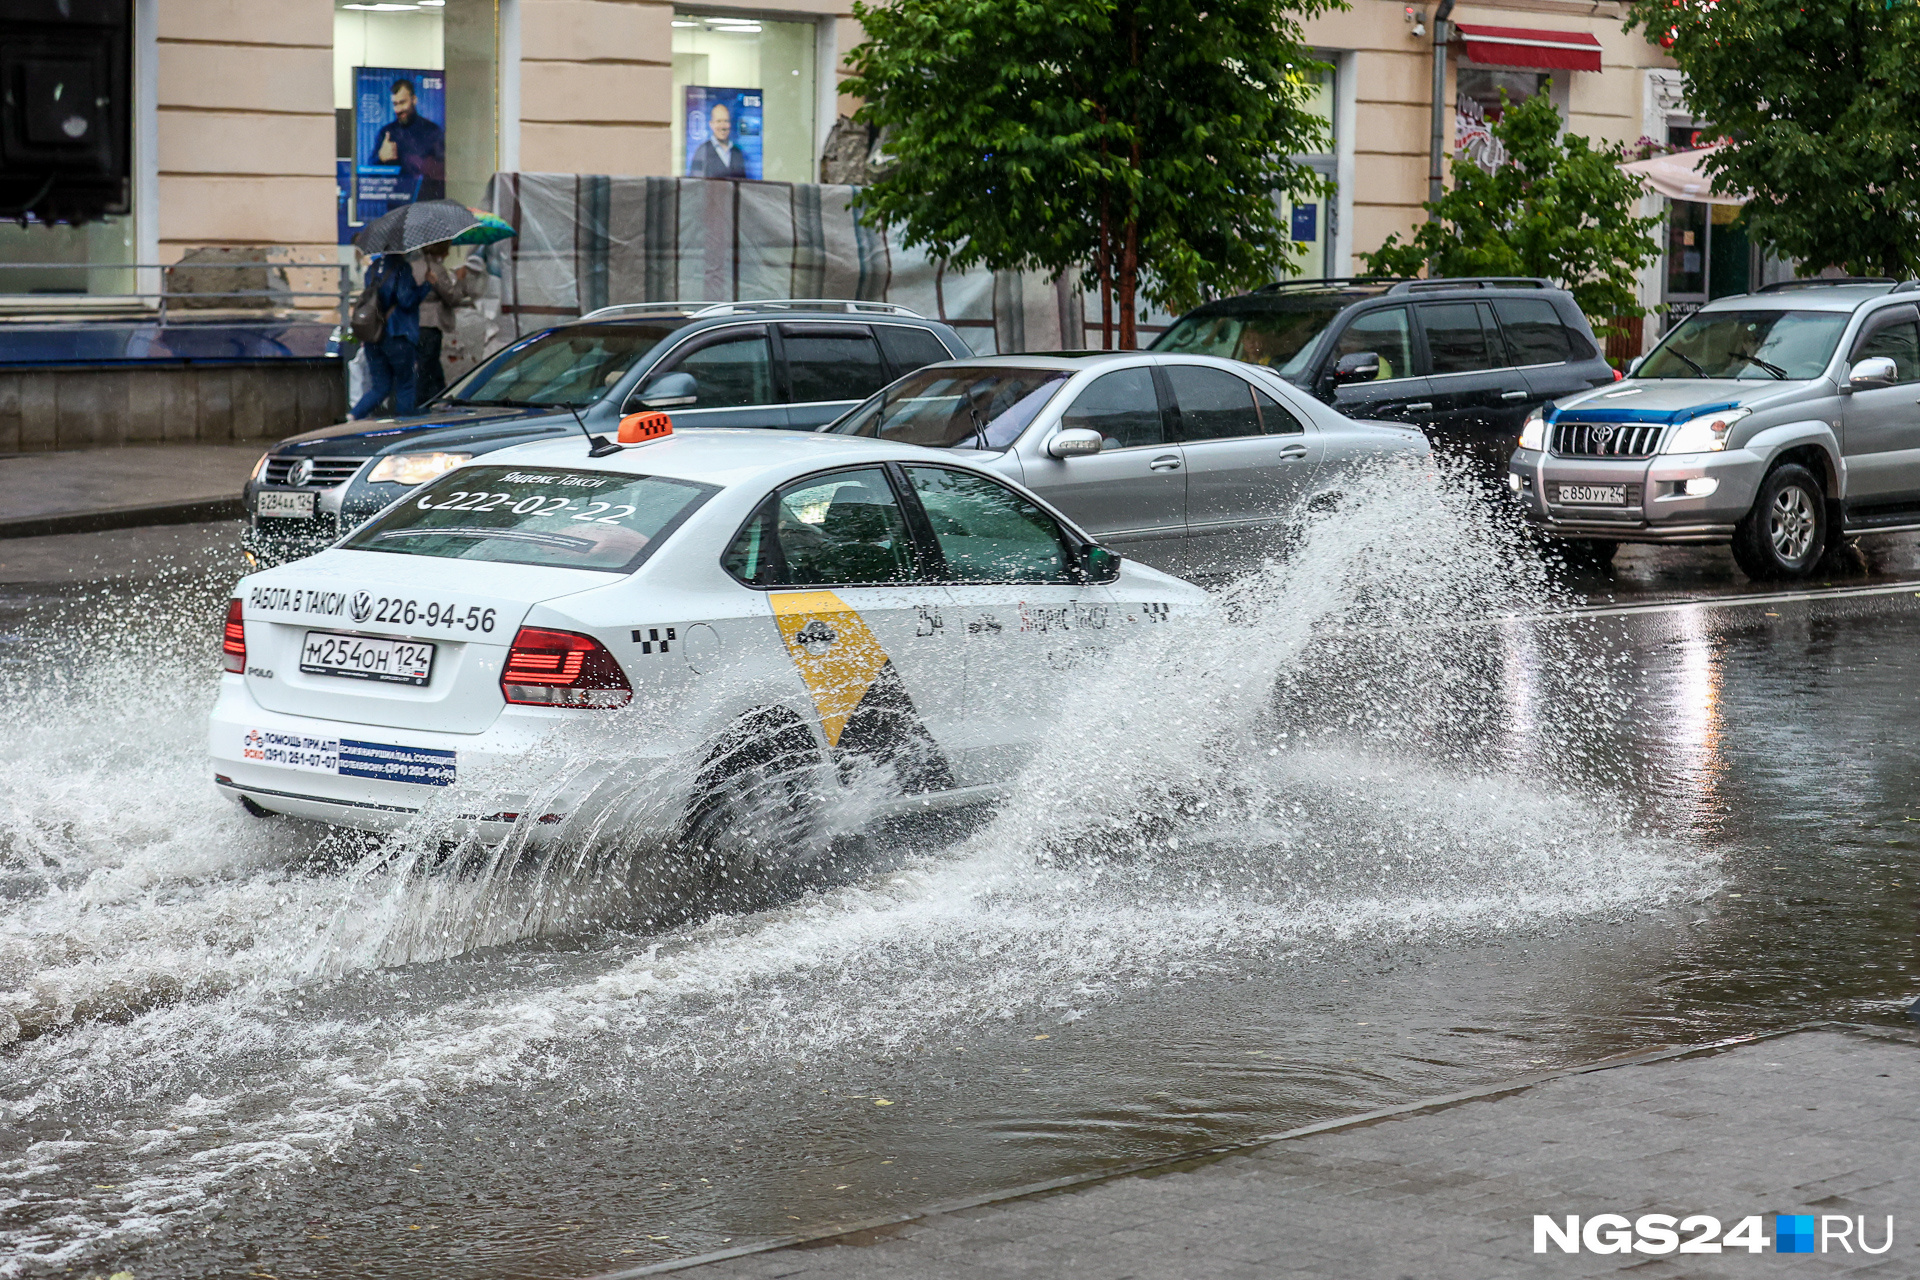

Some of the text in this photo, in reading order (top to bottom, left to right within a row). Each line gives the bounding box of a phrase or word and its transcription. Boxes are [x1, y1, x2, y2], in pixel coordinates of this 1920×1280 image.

[423, 78, 443, 90] ВТБ
[497, 471, 607, 488] Яндекс Такси
[1609, 486, 1621, 498] 24
[431, 491, 637, 525] 222-02-22
[248, 587, 347, 617] РАБОТА В ТАКСИ
[374, 597, 497, 633] 226-94-56
[395, 645, 426, 668] 124
[248, 666, 274, 679] POLO
[264, 732, 338, 752] ПОМОЩЬ ПРИ ДТП
[361, 748, 395, 760] НАРУШИЛ
[413, 753, 456, 766] СООБЩИТЕ
